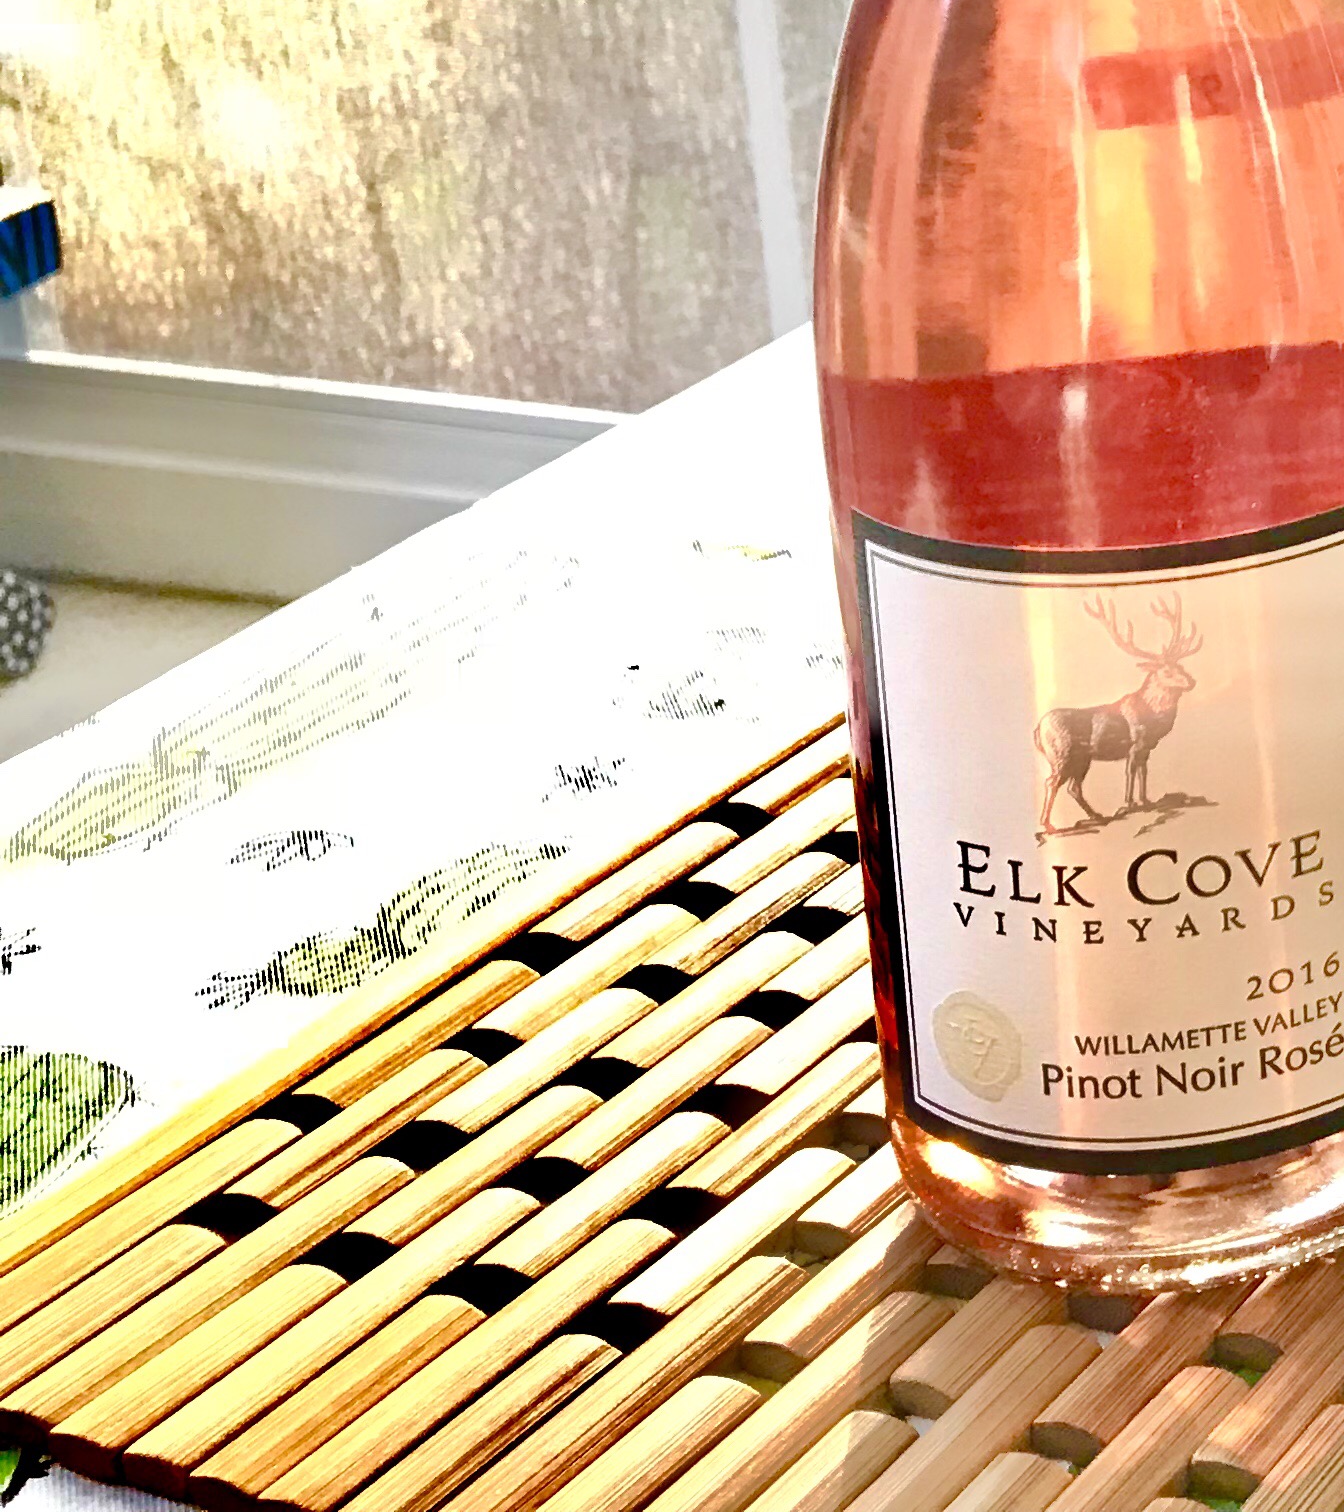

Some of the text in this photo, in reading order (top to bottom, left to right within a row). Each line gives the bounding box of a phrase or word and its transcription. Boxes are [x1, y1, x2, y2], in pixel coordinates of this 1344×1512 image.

[956, 829, 1326, 908] ELK COVE
[952, 880, 1336, 945] VINEYARDS
[1246, 951, 1343, 1002] 2016
[1073, 992, 1344, 1057] WILLAMETTE VALLEY
[1041, 1061, 1142, 1100] Pinot
[1155, 1056, 1246, 1097] Noir
